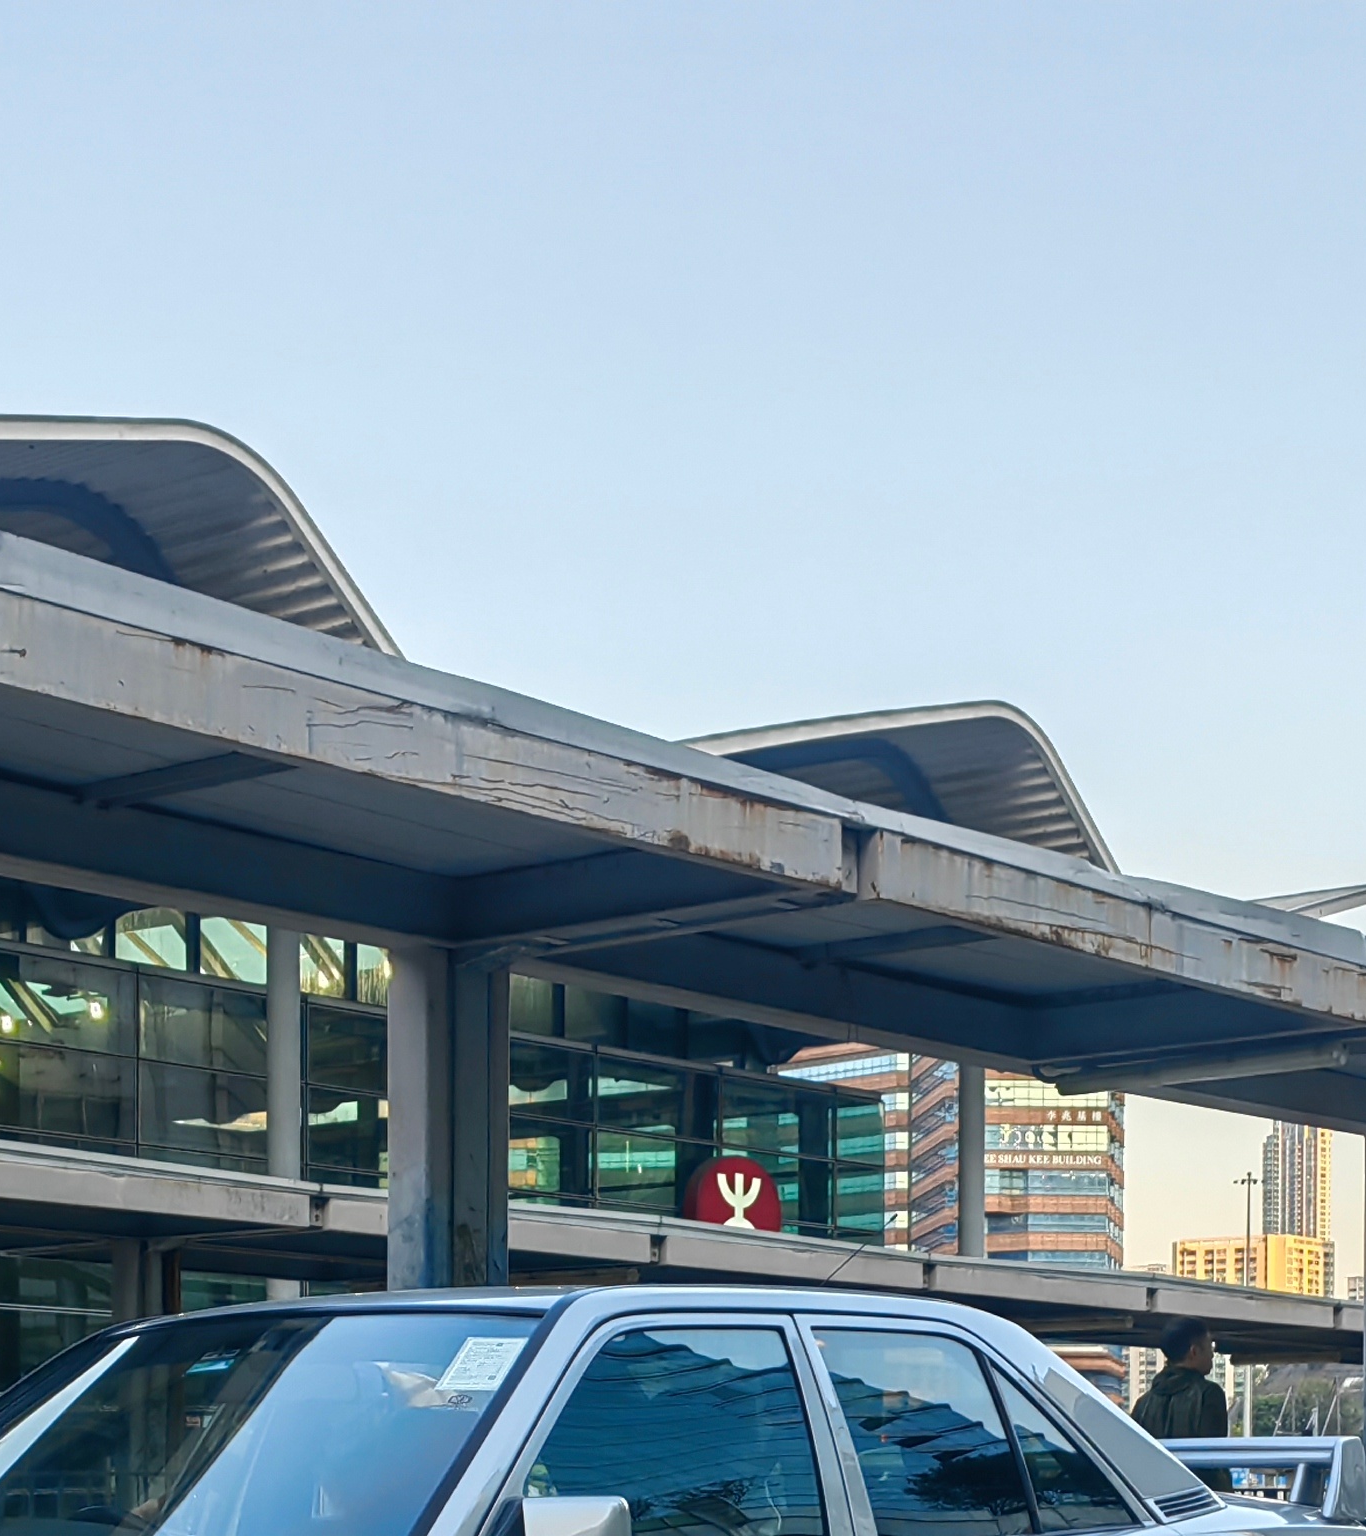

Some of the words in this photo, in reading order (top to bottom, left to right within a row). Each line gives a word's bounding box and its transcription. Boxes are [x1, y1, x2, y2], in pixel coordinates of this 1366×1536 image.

[984, 1154, 996, 1164] EE
[998, 1153, 1026, 1164] SHAU
[1028, 1154, 1051, 1164] KEE
[1052, 1154, 1102, 1165] BUILDING
